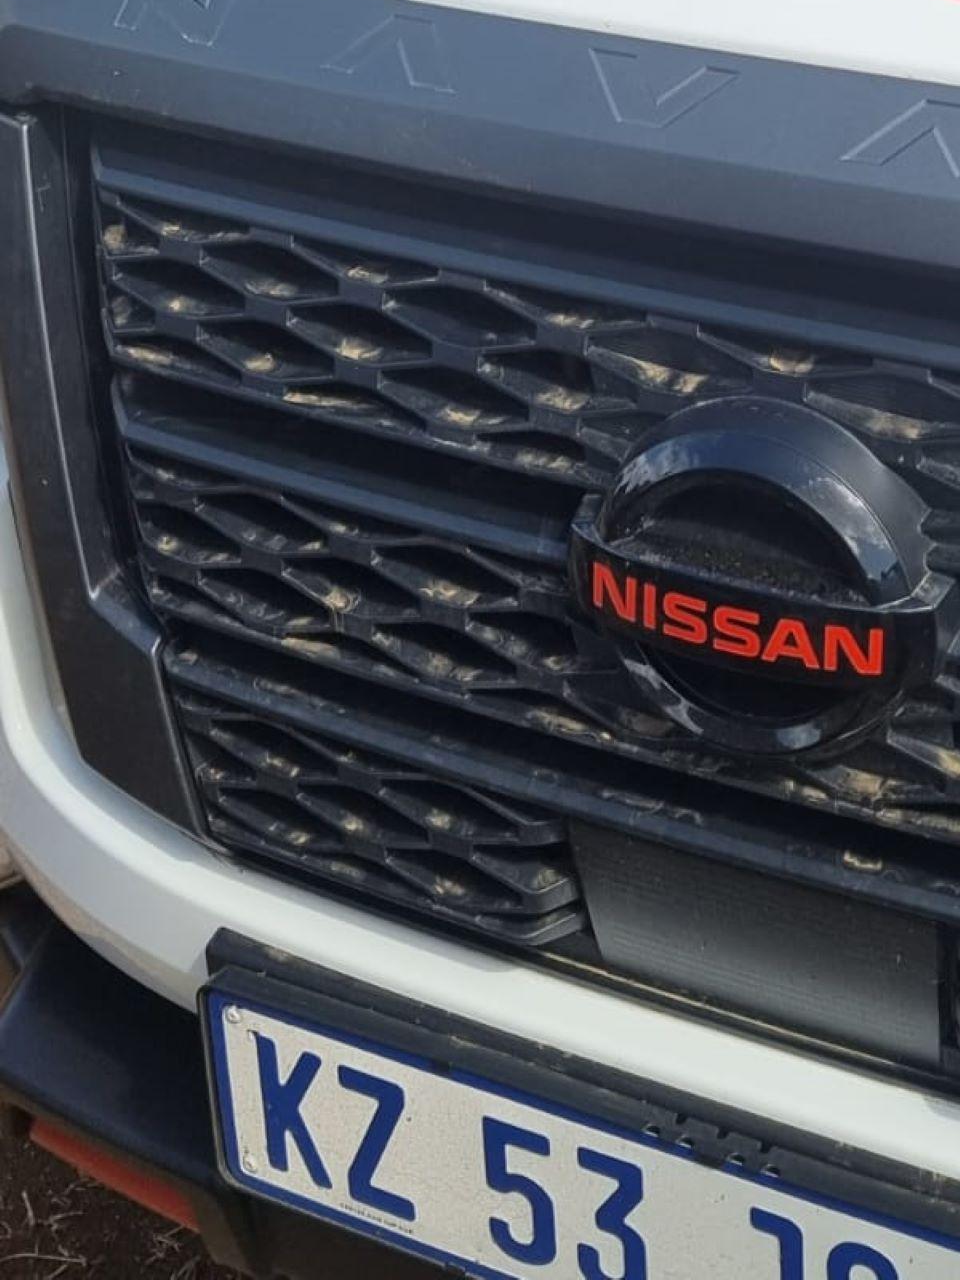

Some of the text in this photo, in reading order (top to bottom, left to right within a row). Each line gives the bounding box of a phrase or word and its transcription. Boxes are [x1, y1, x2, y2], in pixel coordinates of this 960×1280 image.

[592, 560, 885, 676] NISSAN
[254, 1030, 416, 1222] KZ
[481, 1116, 648, 1280] 53
